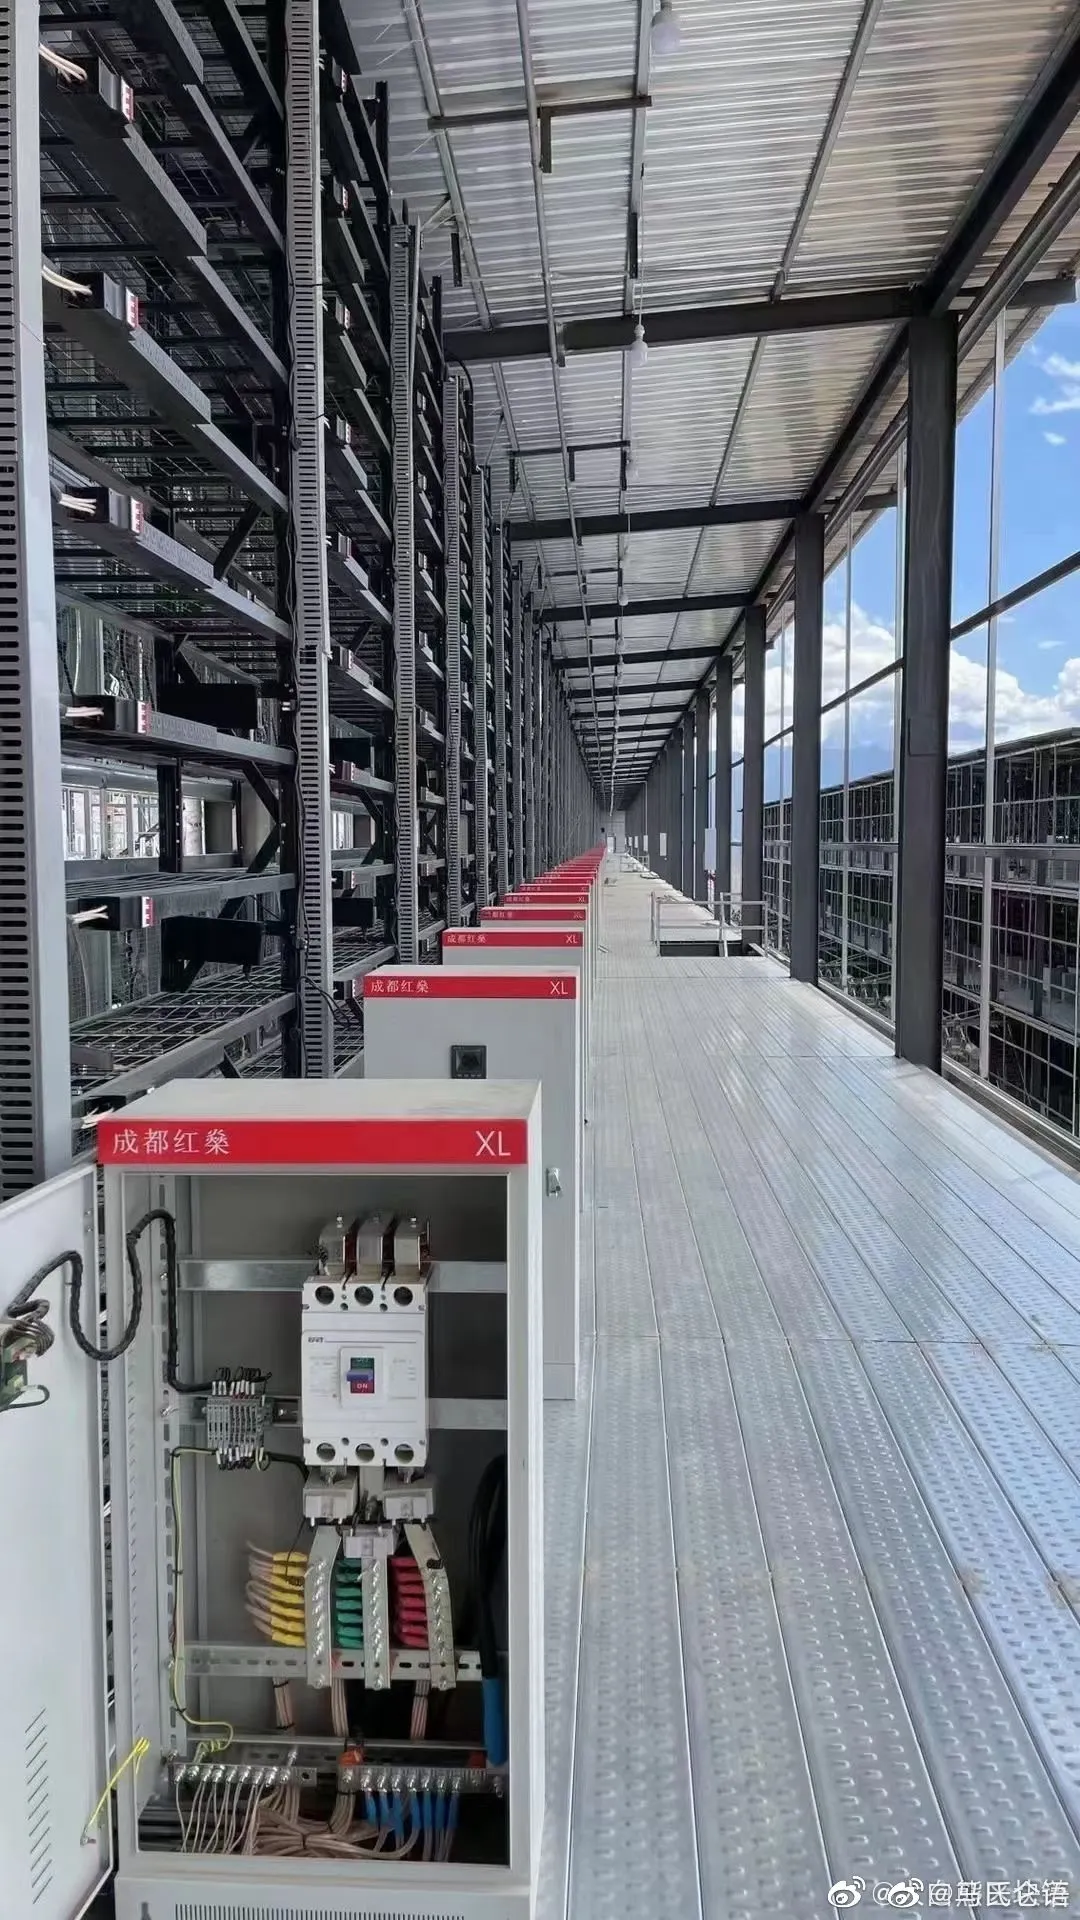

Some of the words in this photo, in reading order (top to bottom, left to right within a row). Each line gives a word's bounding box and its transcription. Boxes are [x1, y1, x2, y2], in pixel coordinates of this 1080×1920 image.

[565, 934, 578, 944] XL
[371, 980, 429, 993] 成都红燊
[550, 981, 568, 995] XL
[112, 1128, 230, 1155] 成都红燊
[475, 1130, 511, 1157] XL
